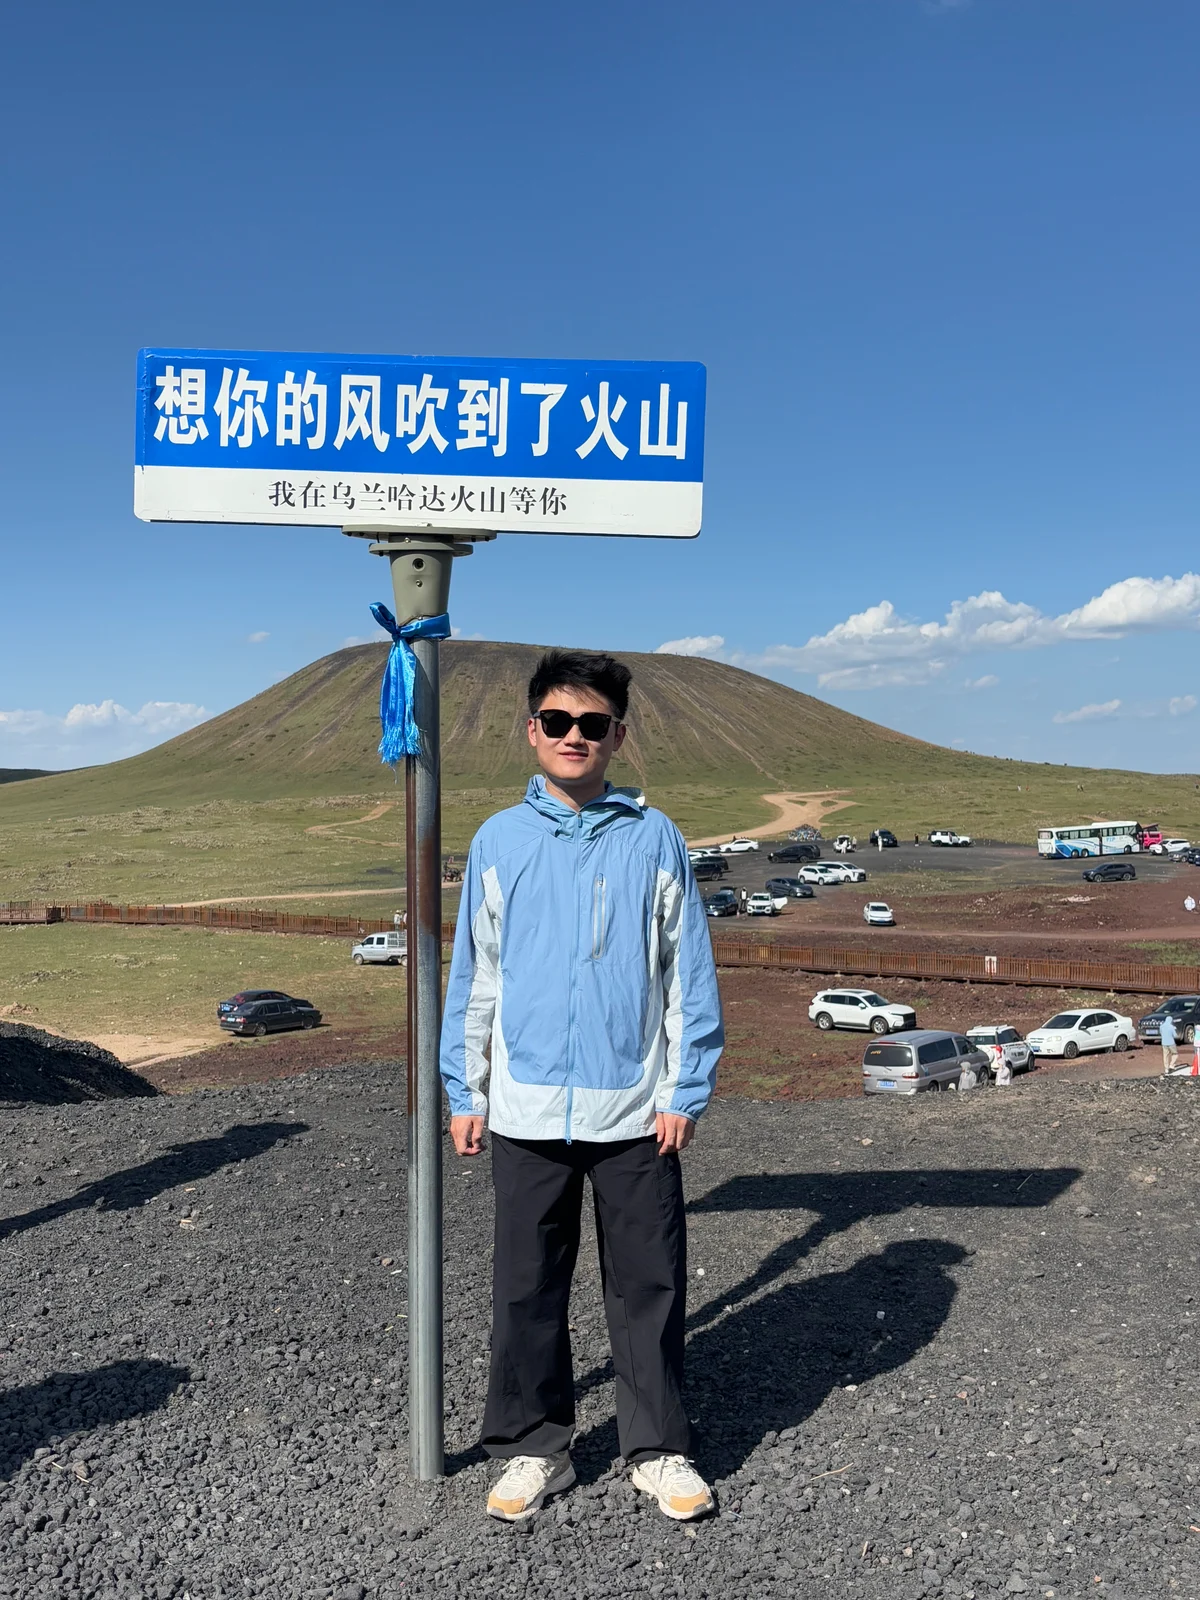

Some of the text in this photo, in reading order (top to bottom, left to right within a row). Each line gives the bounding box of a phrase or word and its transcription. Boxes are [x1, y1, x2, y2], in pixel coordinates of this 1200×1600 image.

[154, 366, 688, 461] 想你的风吹到了火山
[268, 480, 567, 516] 我在乌兰哈达火山等你
